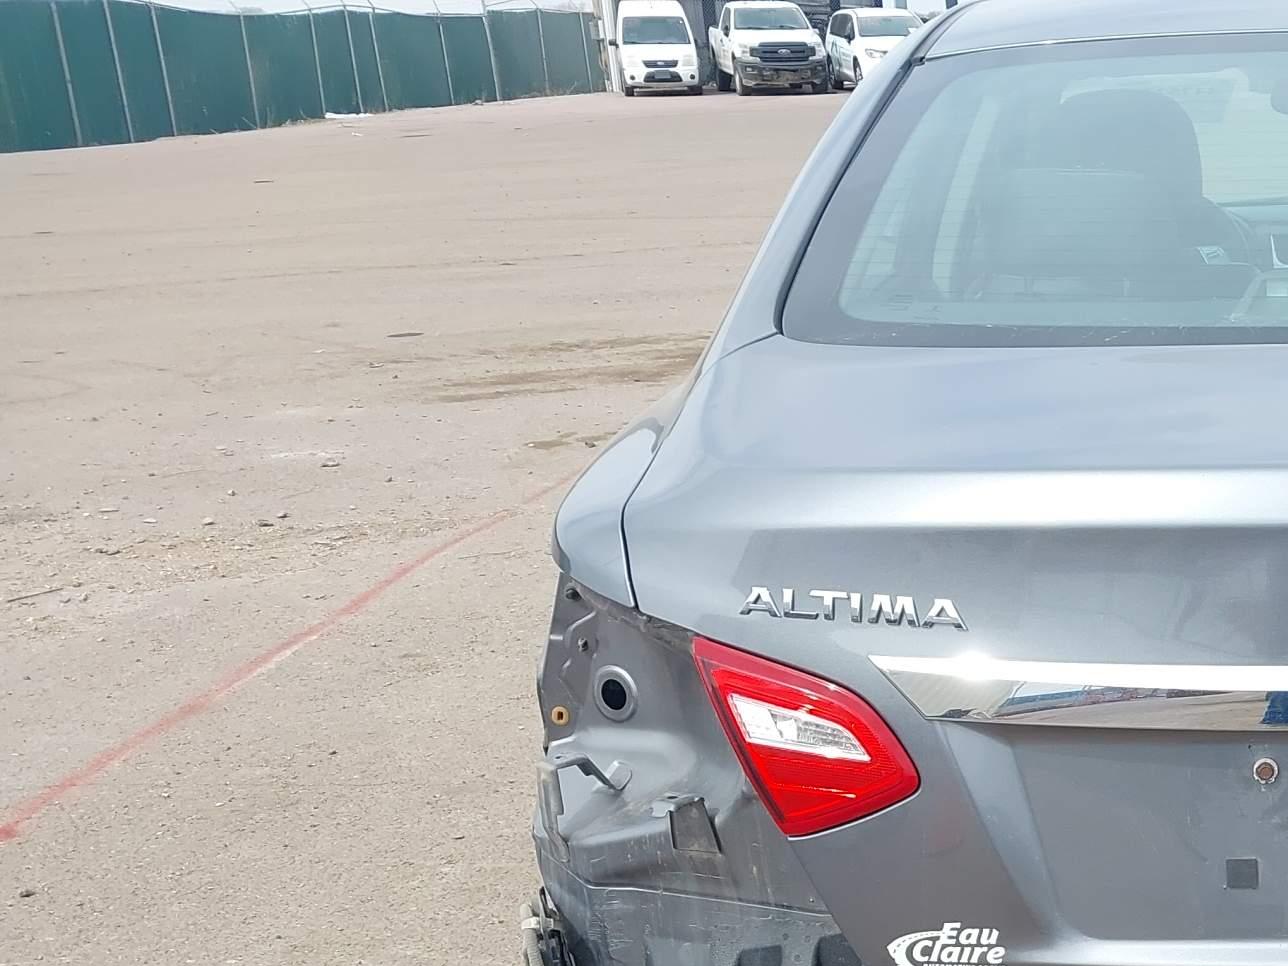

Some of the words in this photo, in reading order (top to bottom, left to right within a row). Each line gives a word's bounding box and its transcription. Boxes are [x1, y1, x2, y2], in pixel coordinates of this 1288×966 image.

[739, 585, 969, 632] ALTIMA
[939, 921, 1000, 946] Eau
[912, 939, 1006, 964] Claire
